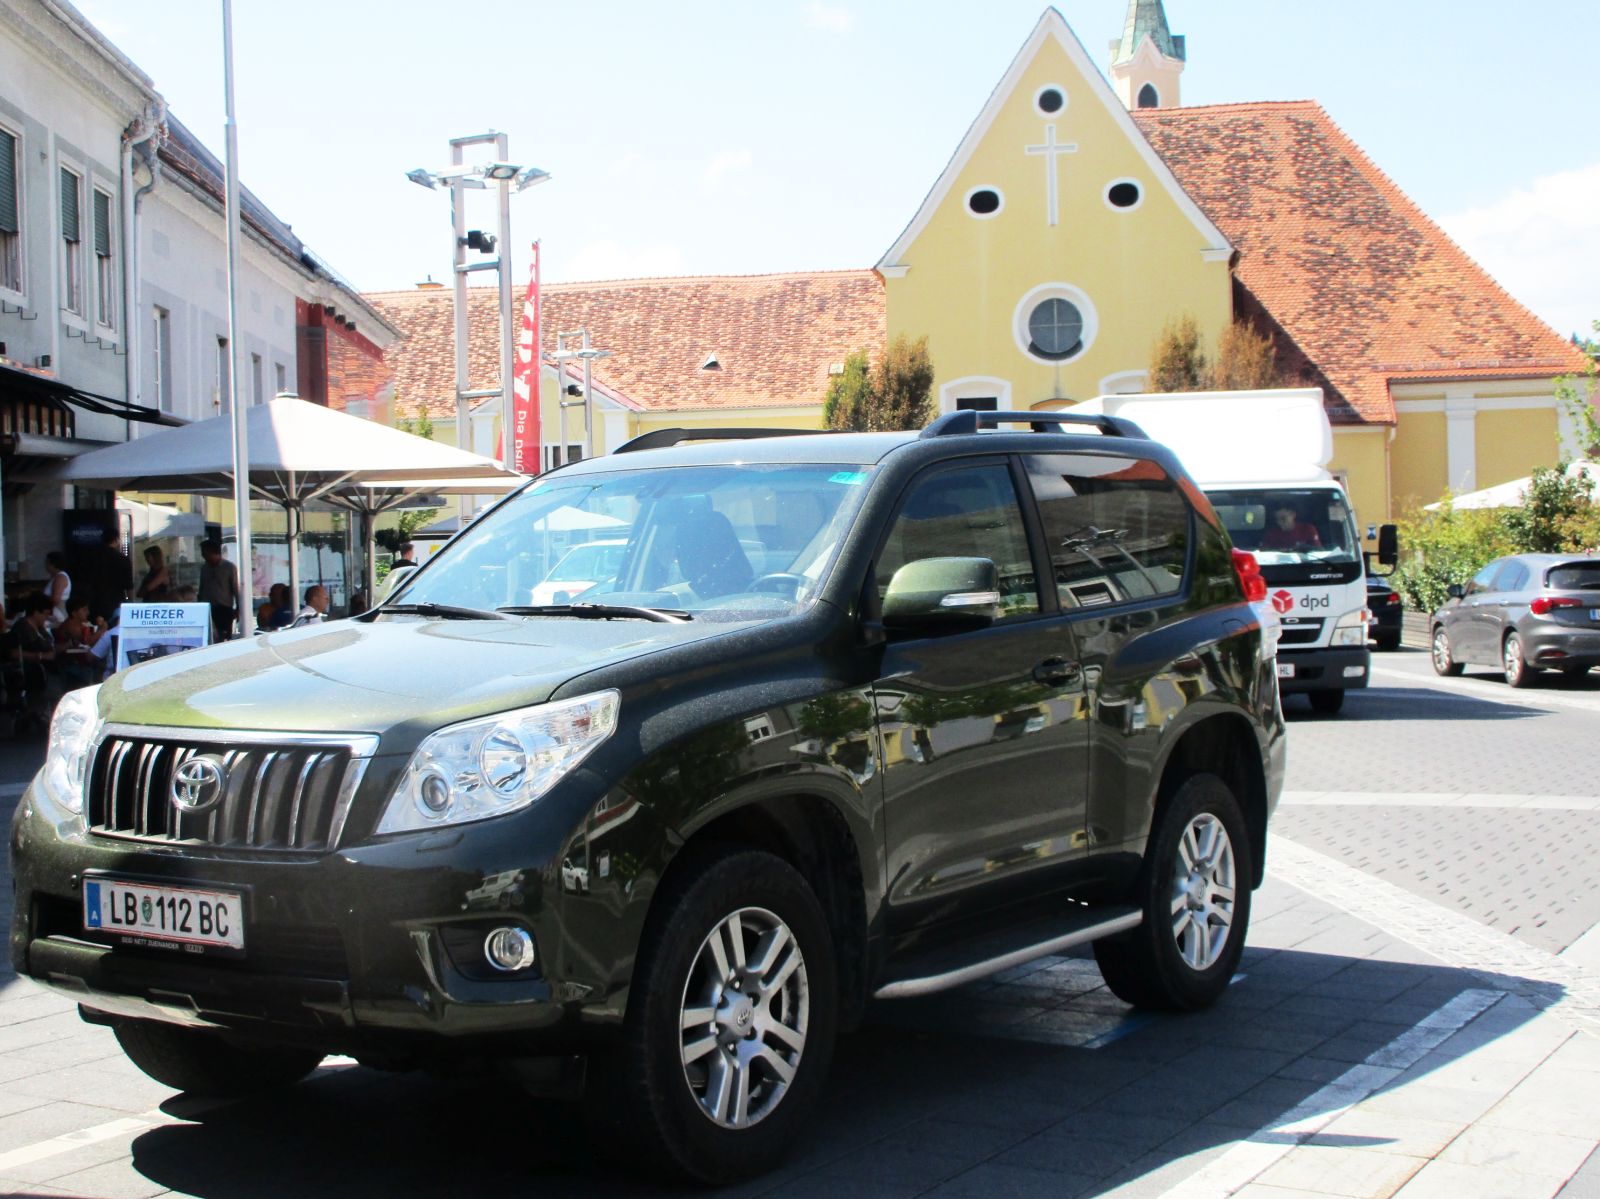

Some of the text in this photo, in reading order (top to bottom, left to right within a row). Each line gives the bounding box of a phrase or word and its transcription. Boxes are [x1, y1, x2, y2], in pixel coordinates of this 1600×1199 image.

[1299, 594, 1330, 611] dpd
[131, 609, 184, 619] HIERZER
[111, 891, 137, 926] LB
[156, 896, 193, 933] 112
[199, 900, 230, 937] BC
